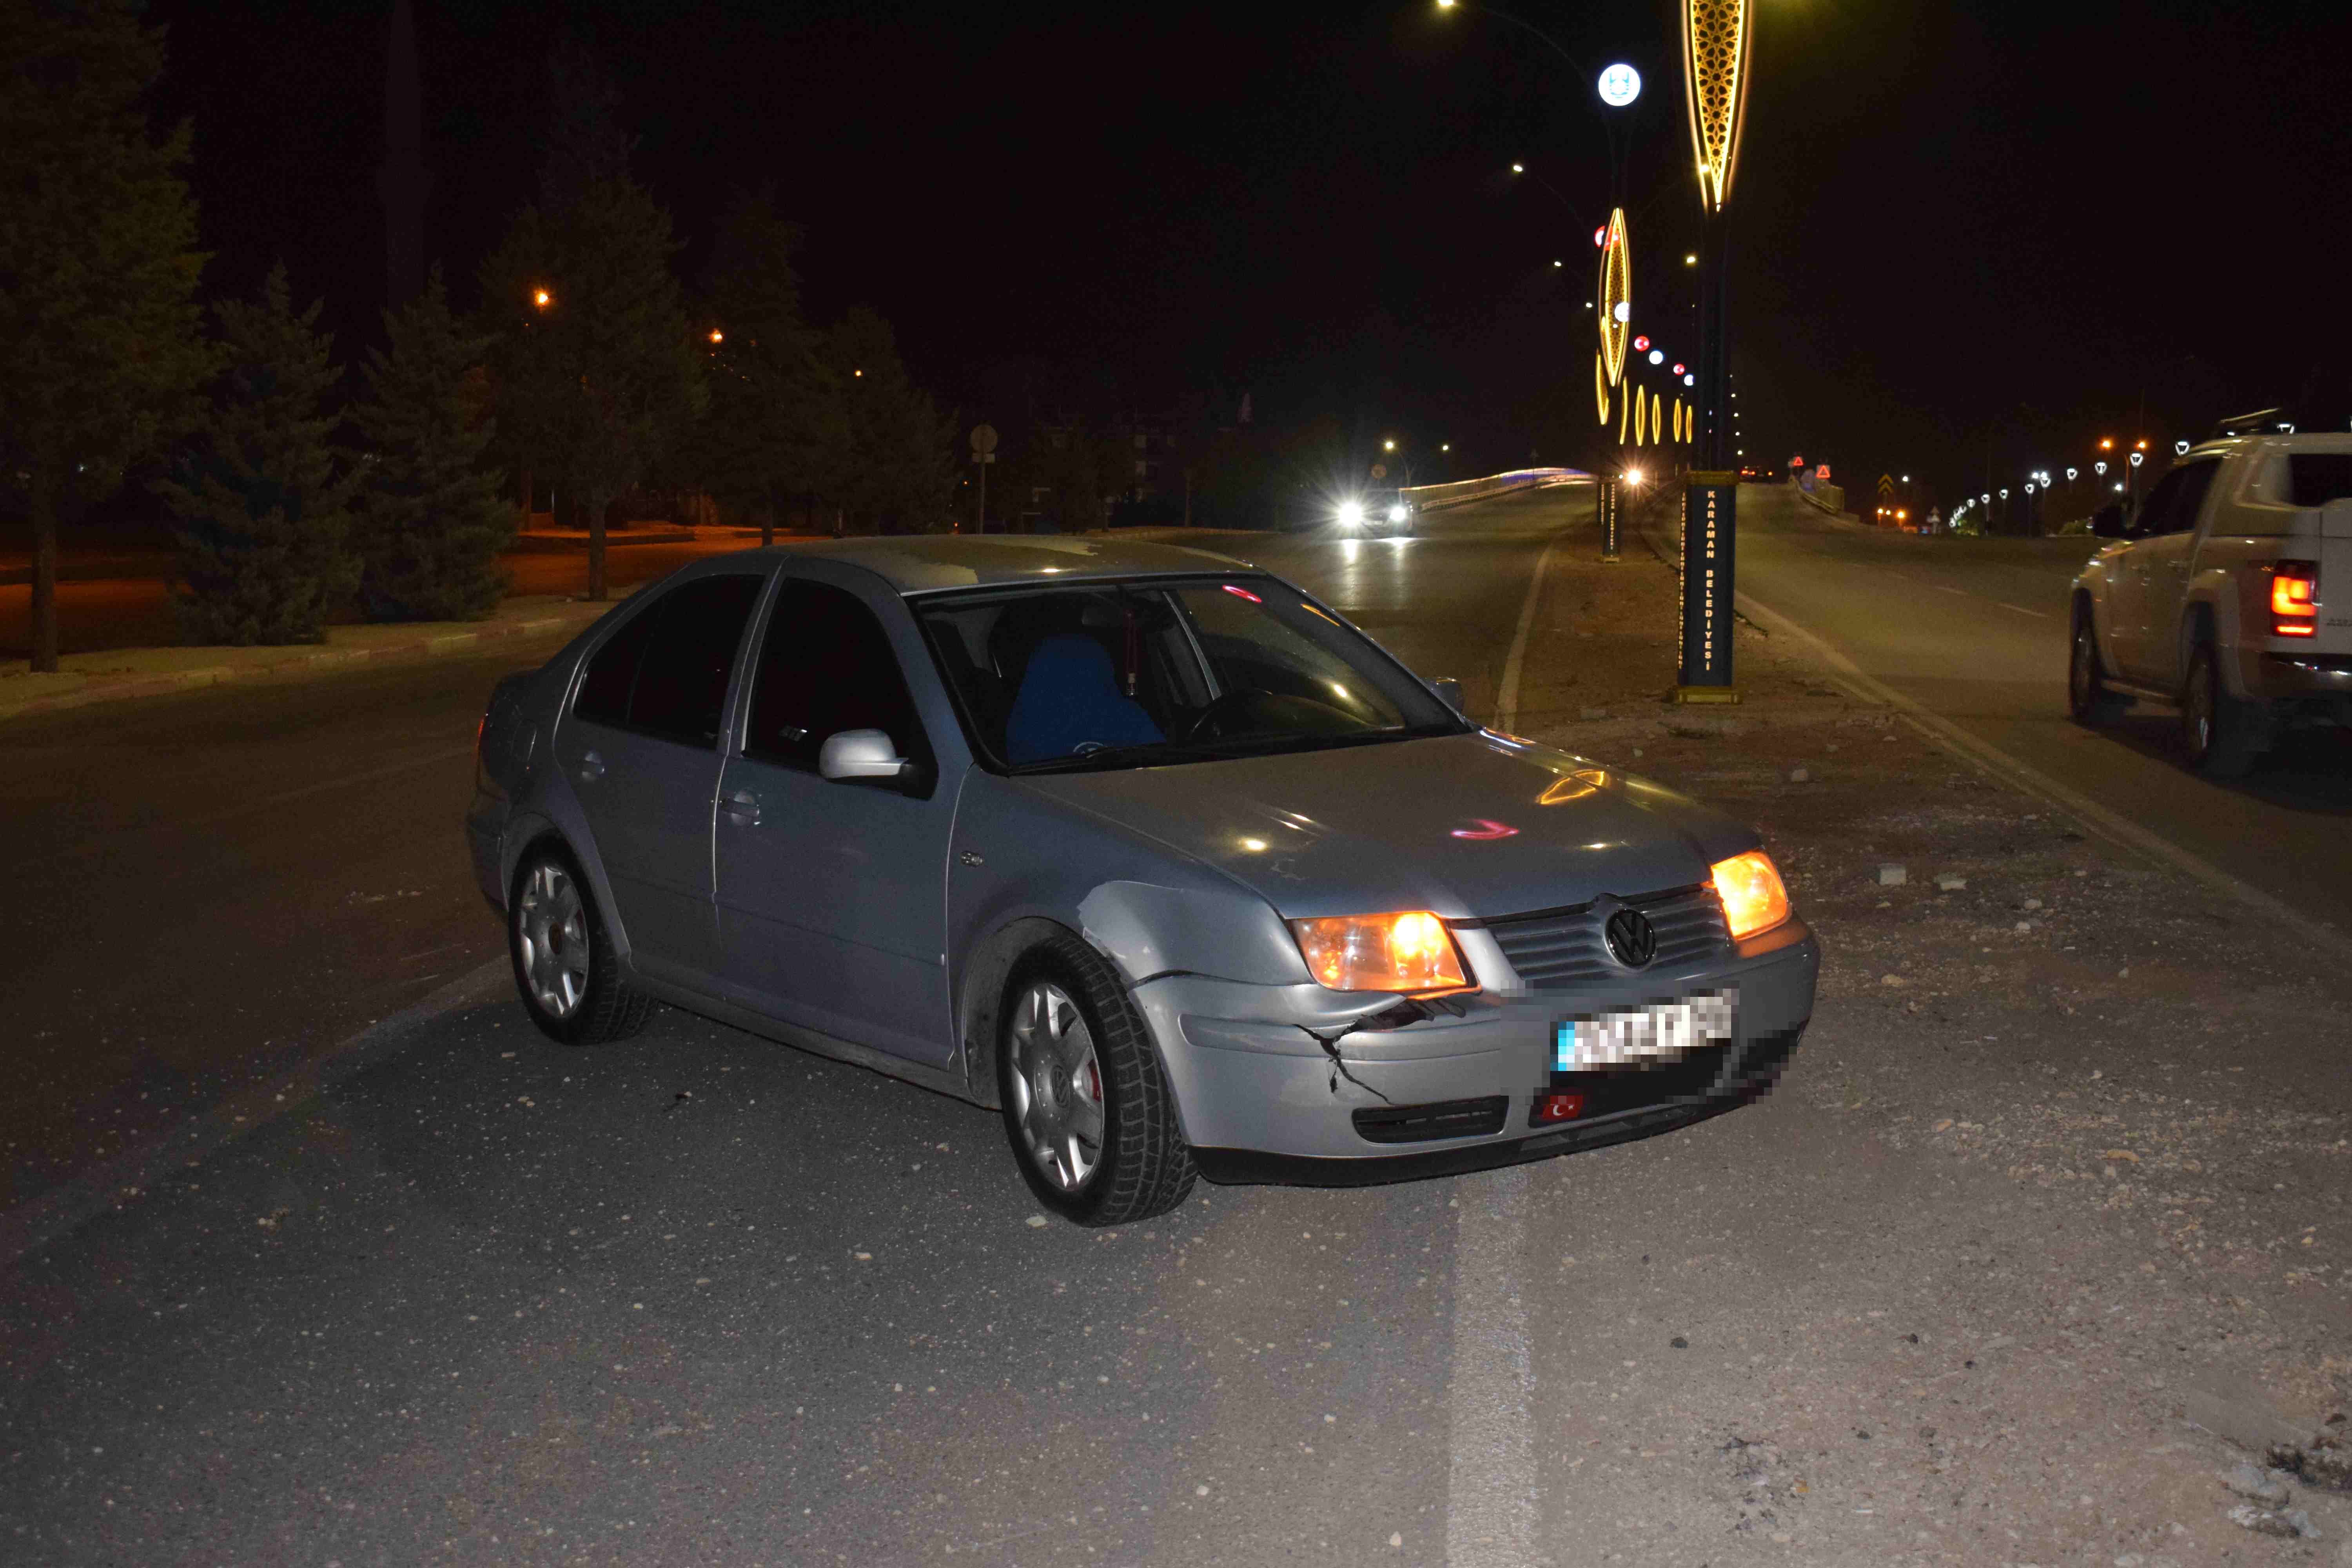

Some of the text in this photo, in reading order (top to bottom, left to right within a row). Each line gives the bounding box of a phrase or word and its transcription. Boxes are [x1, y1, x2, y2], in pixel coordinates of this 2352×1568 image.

[1705, 491, 1715, 670] KARAMAN BELEDİYESİ
[1606, 910, 1656, 966] VW
